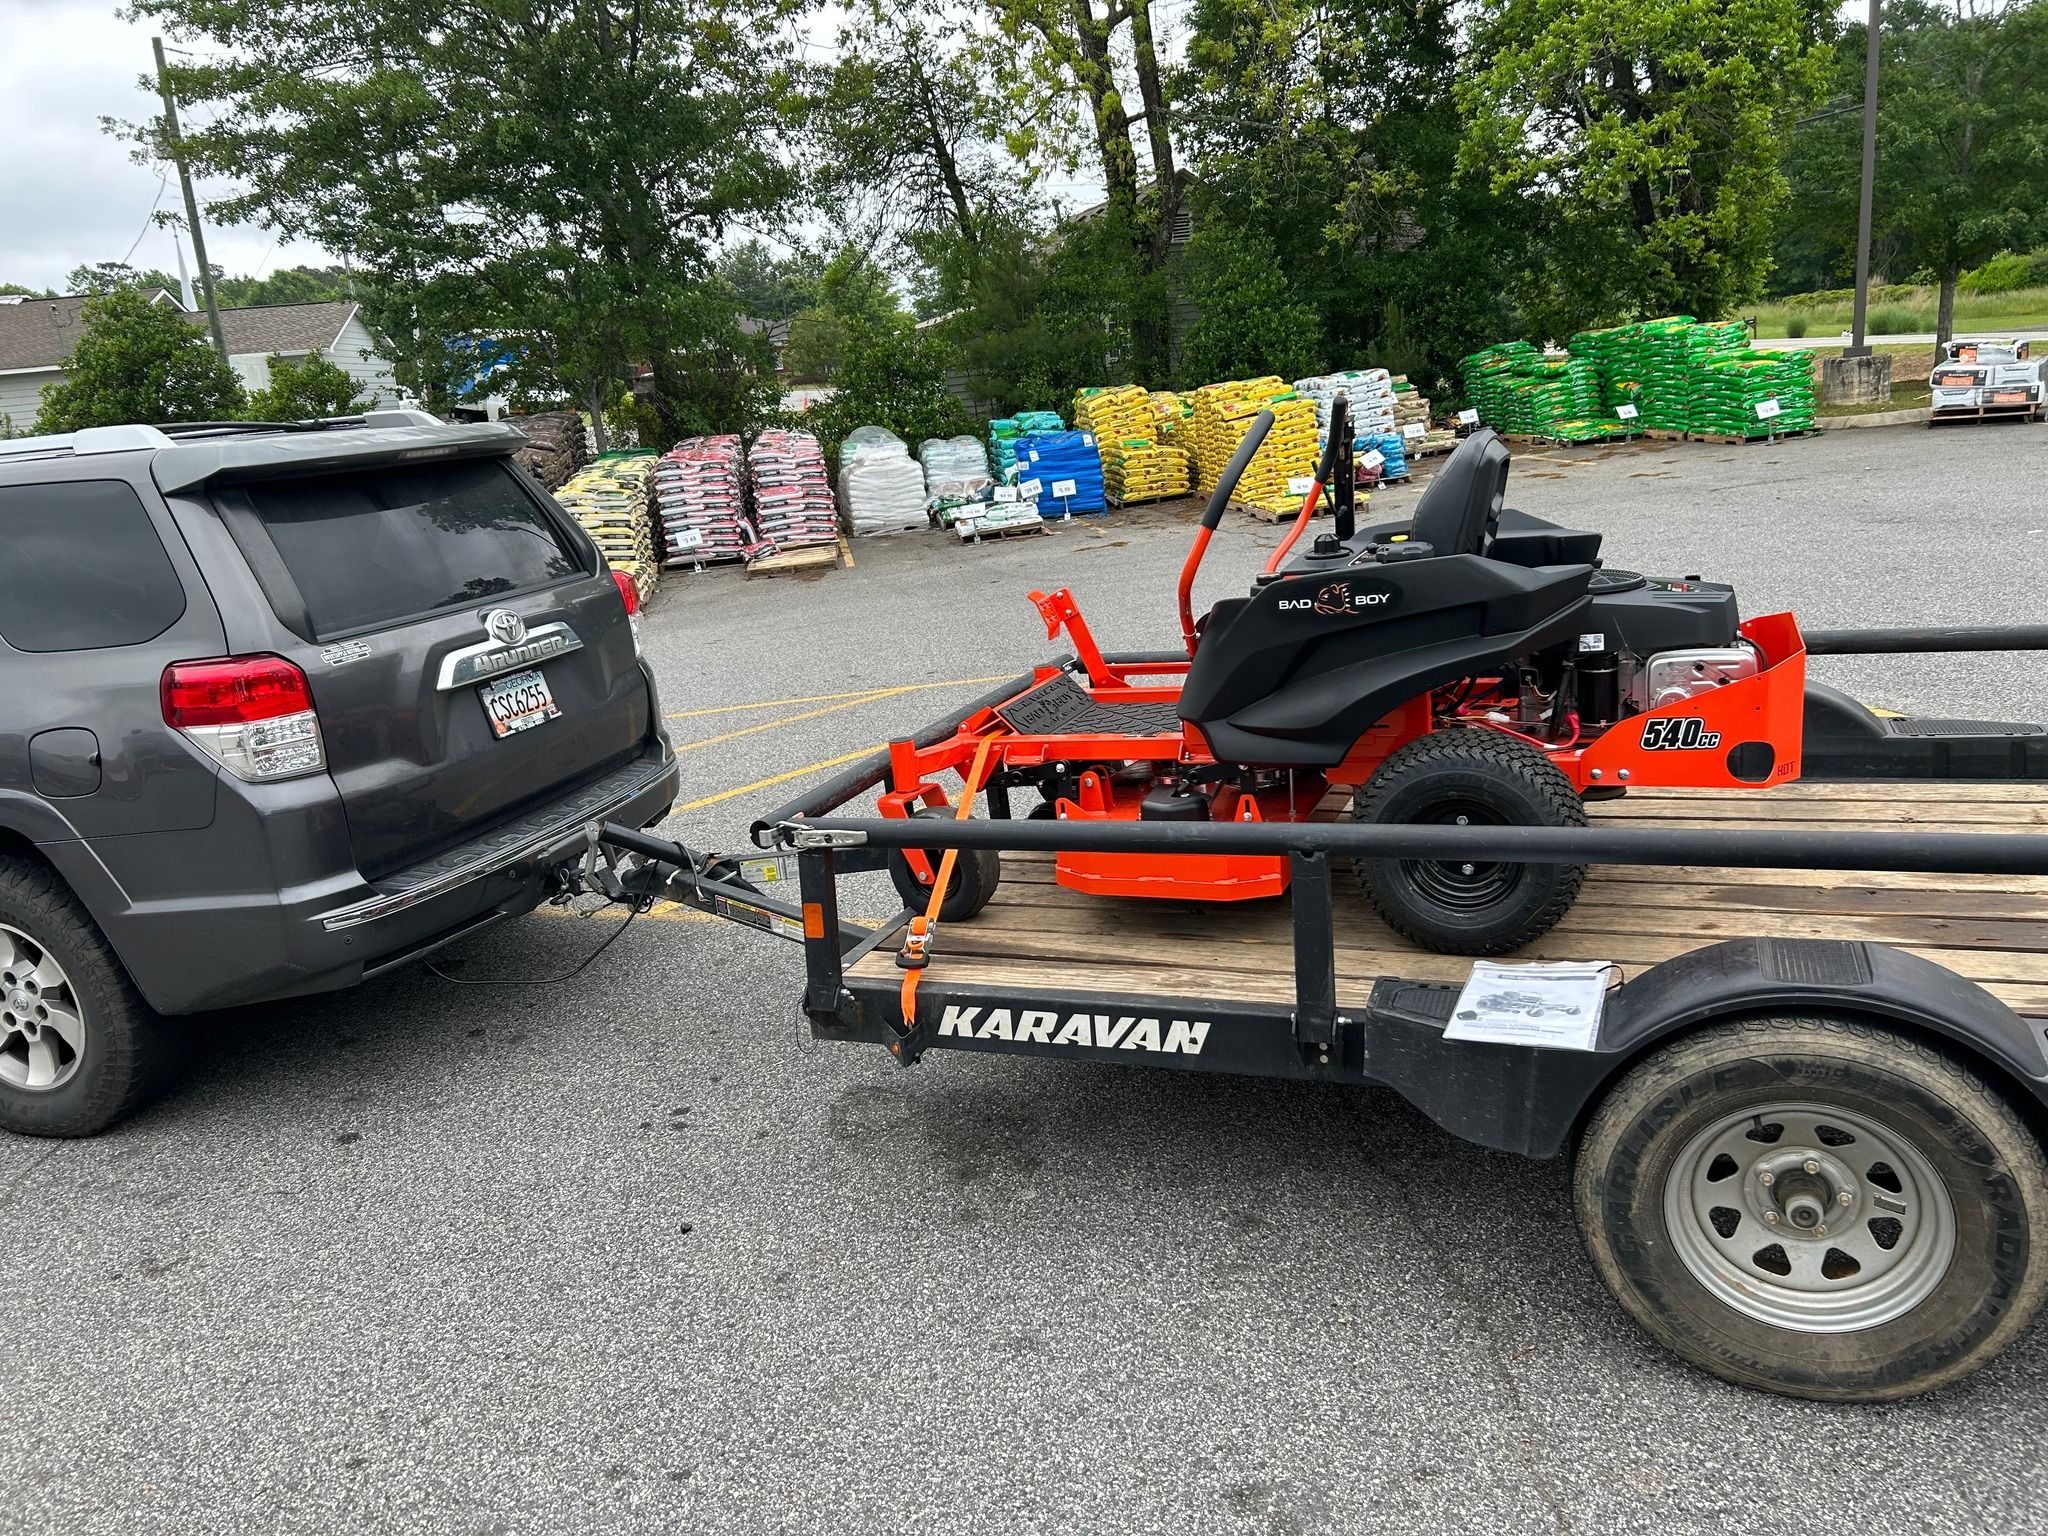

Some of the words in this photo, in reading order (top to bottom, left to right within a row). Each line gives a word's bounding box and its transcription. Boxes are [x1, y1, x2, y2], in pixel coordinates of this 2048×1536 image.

[1278, 599, 1312, 610] BAD
[1355, 593, 1391, 606] BOY
[489, 682, 547, 723] CSC6255
[937, 1004, 1212, 1055] KARAVAN
